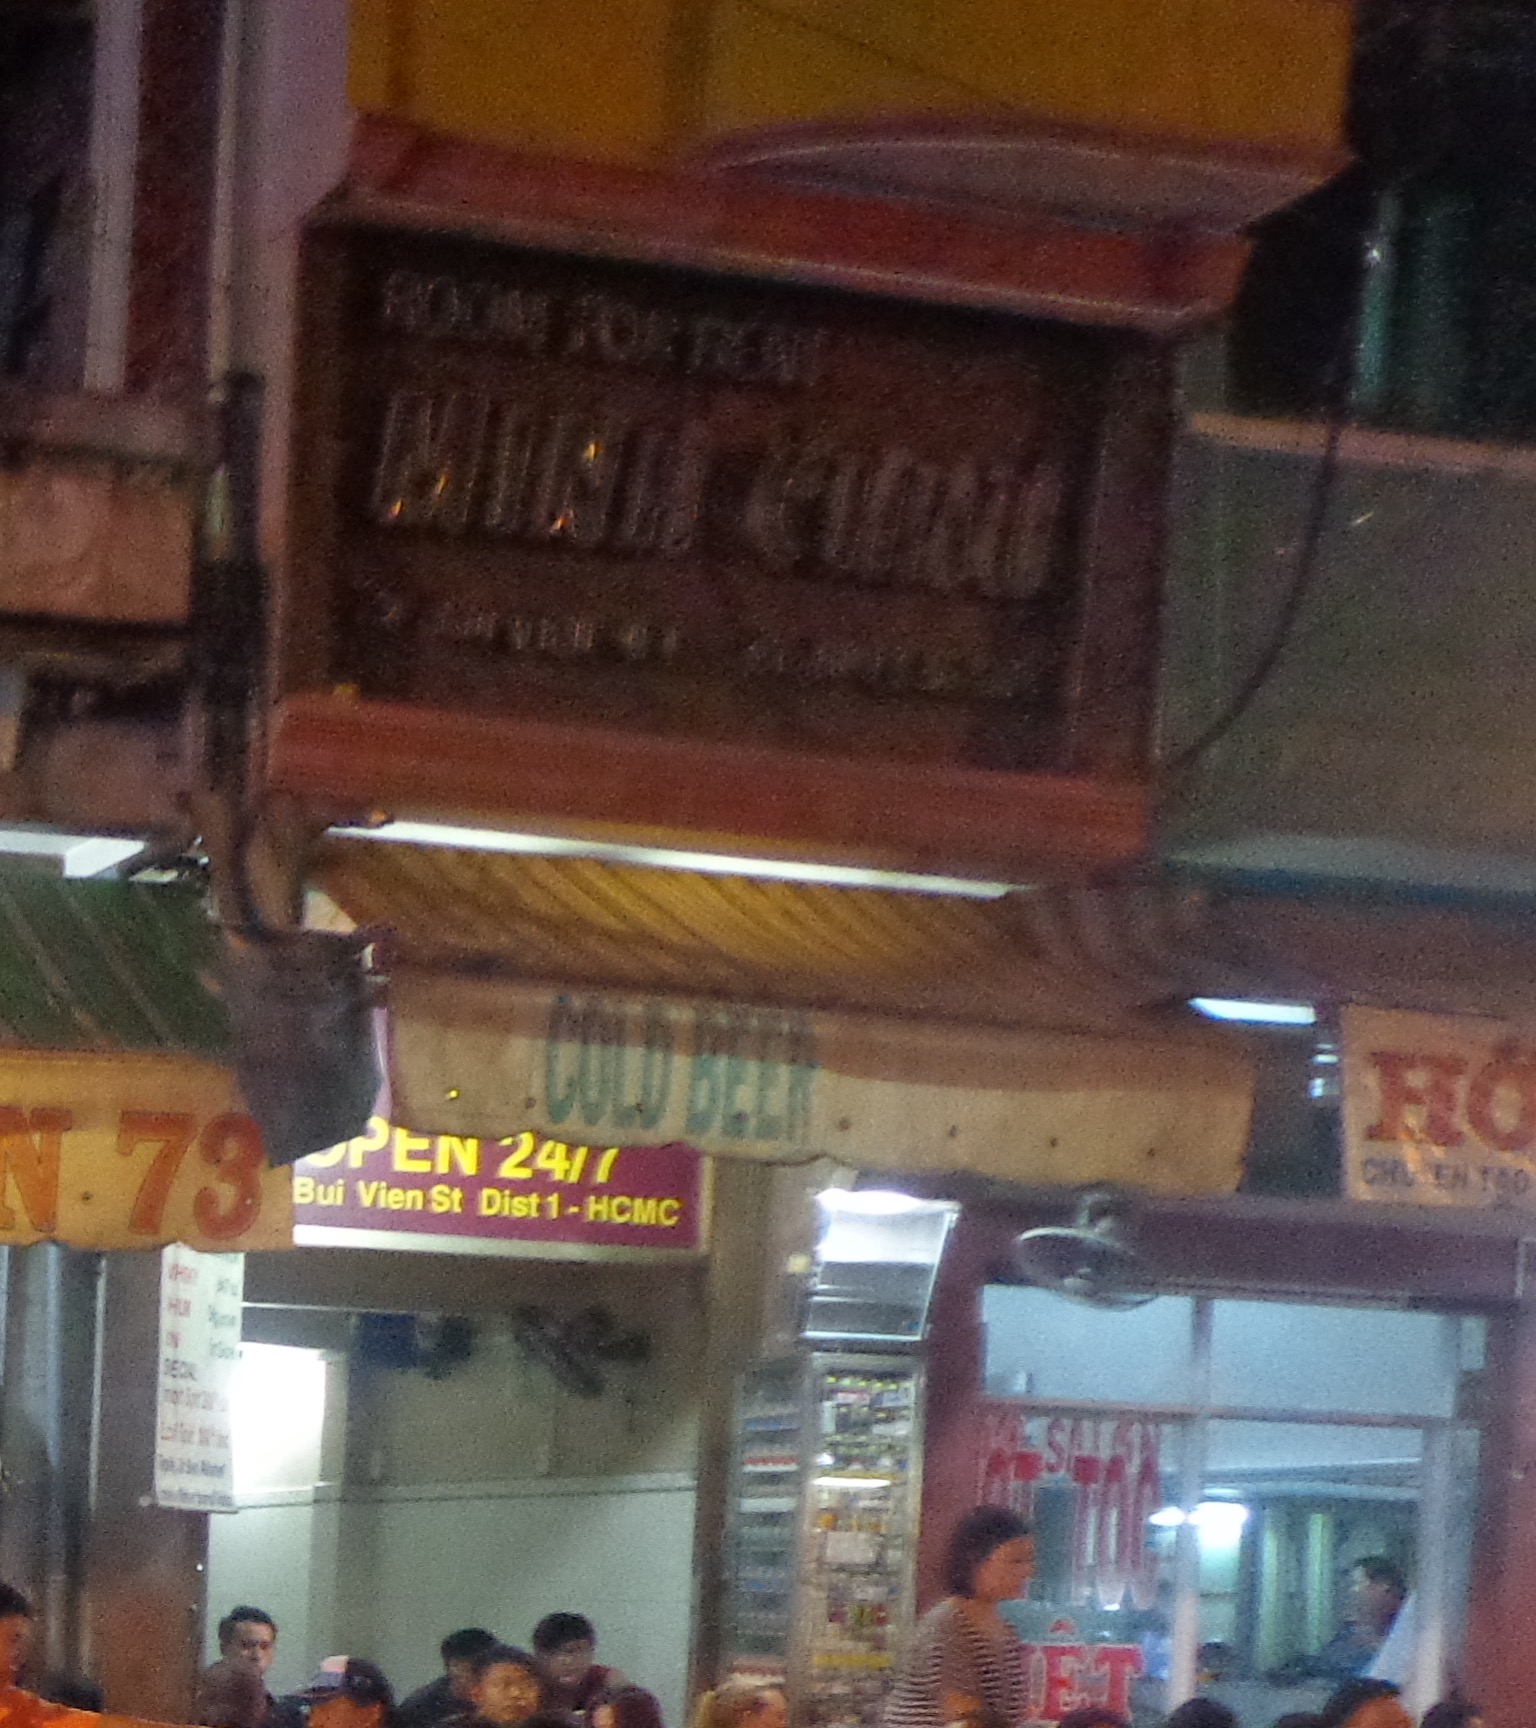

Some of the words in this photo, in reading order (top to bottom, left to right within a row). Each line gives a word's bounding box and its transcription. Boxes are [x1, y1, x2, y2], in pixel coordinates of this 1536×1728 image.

[543, 995, 672, 1131] COLD
[684, 1002, 818, 1142] BEER
[117, 1110, 264, 1239] 73
[294, 1176, 345, 1207] Bui
[357, 1180, 424, 1211] Vien
[430, 1184, 463, 1214] St
[479, 1187, 540, 1219] Dist
[545, 1192, 560, 1220] 1
[586, 1194, 682, 1228] HCMC
